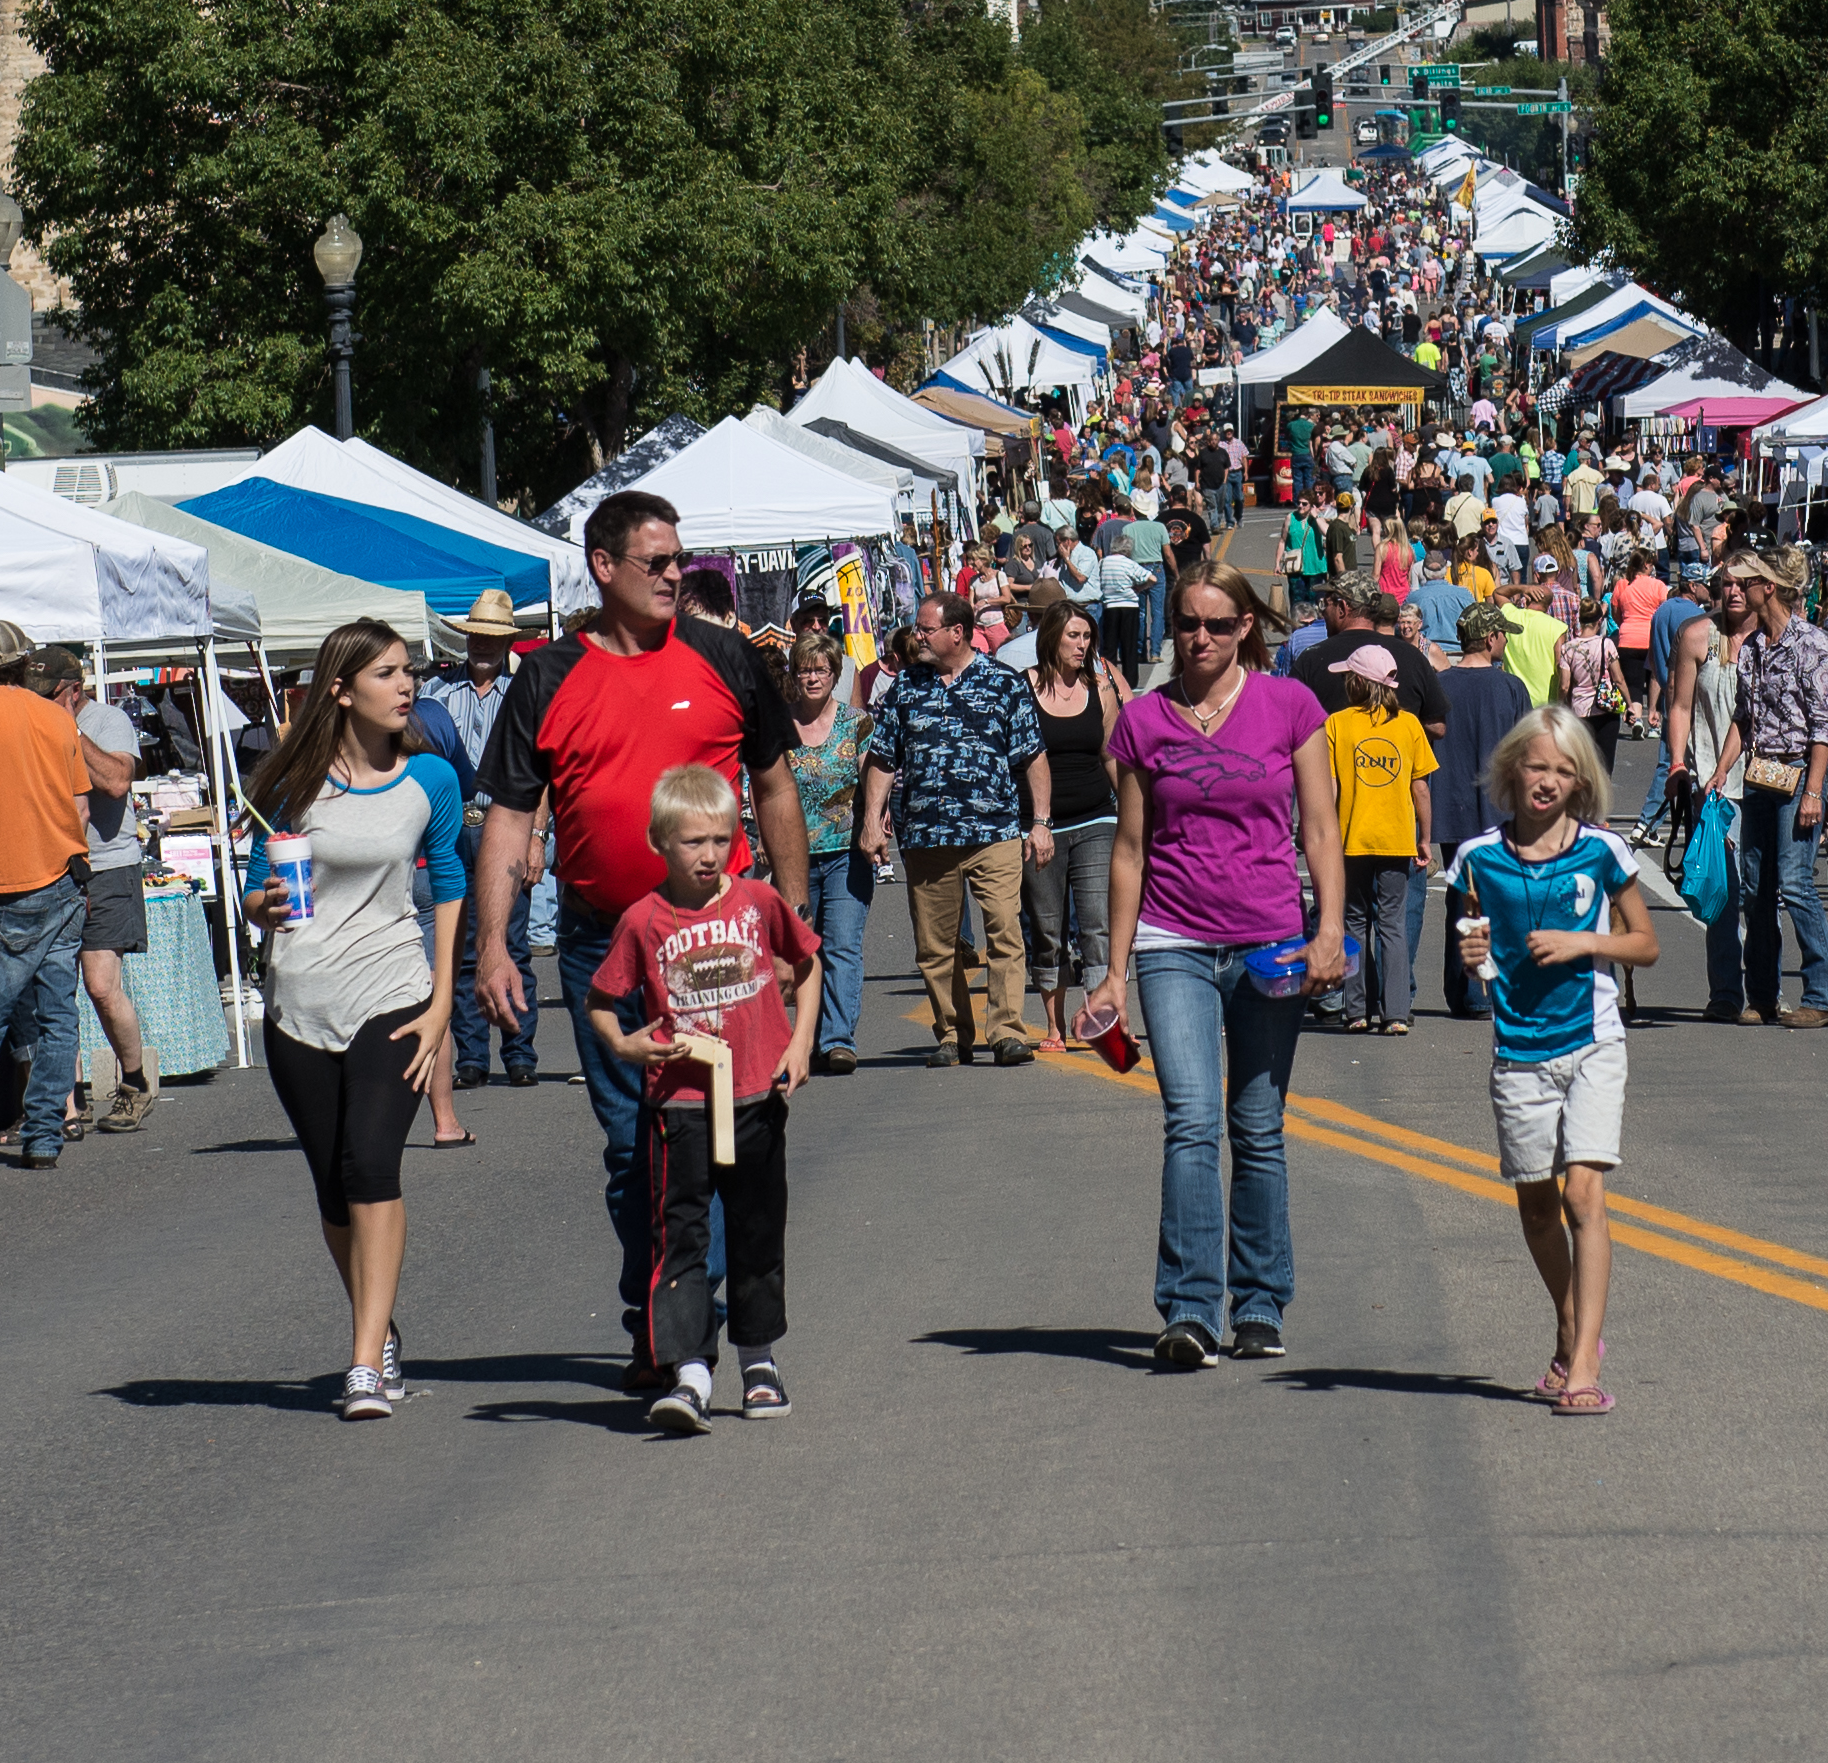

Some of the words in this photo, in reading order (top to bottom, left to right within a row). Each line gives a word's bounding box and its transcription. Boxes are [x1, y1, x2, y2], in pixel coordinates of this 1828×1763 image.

[1313, 391, 1340, 402] TRI-TIP
[1342, 390, 1367, 401] STEAK
[1369, 390, 1418, 401] SANDWICHES
[1356, 756, 1398, 768] QUIT
[656, 919, 763, 974] FOOTBALL
[675, 989, 733, 1007] TRAINING
